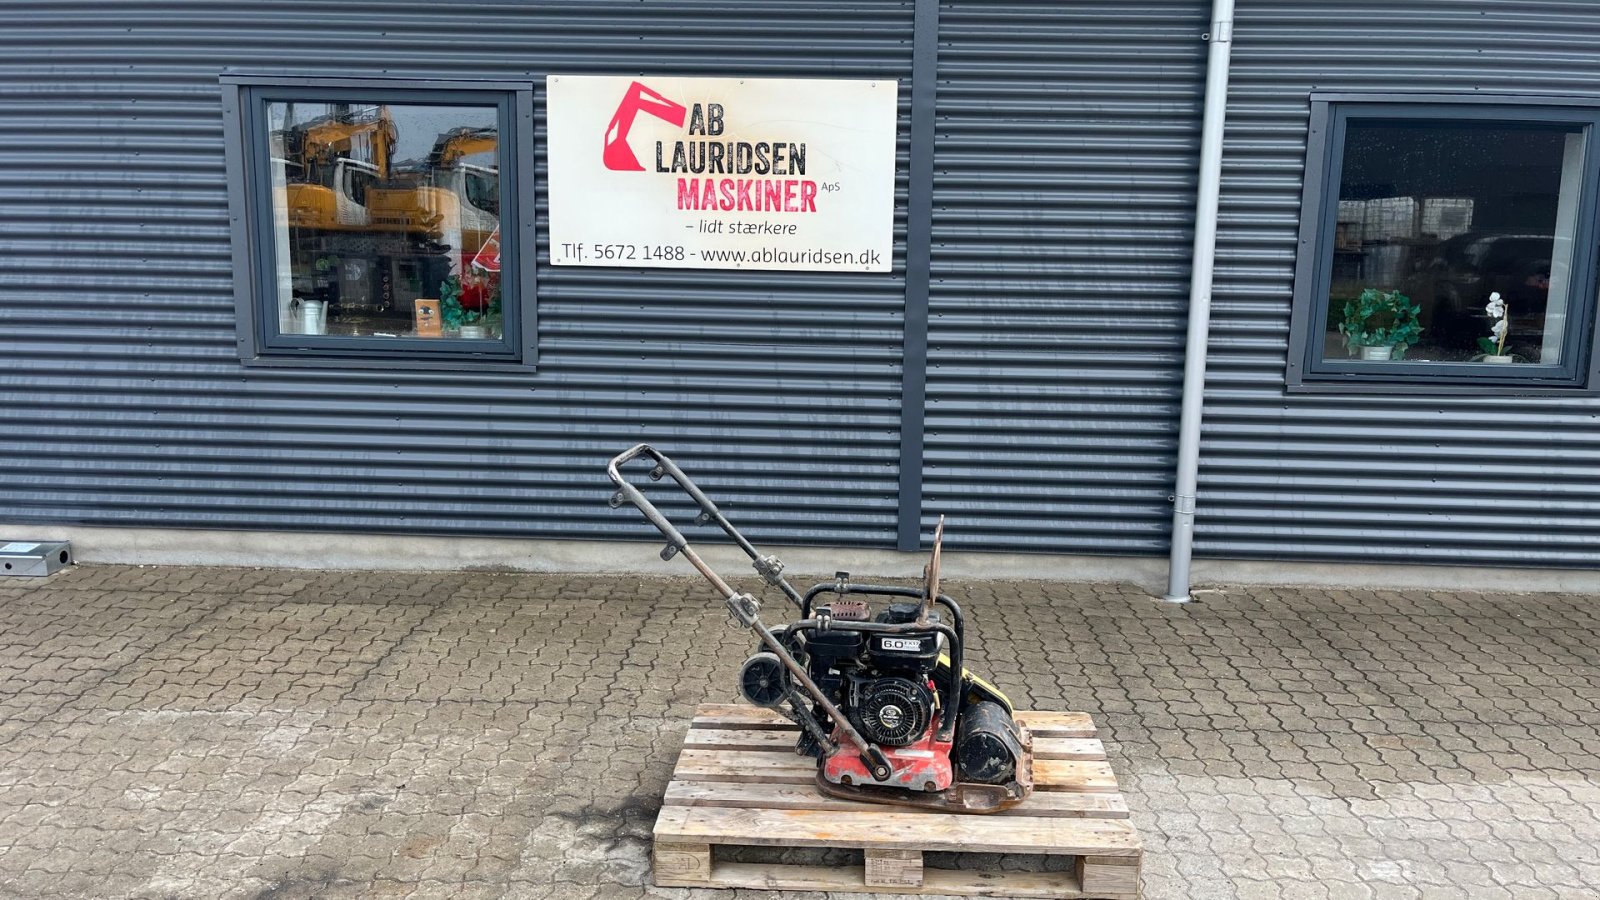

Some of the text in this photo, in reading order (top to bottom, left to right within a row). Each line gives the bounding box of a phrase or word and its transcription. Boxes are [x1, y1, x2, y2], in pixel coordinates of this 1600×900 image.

[688, 103, 725, 136] AB
[656, 141, 806, 176] LAURIDSEN
[677, 178, 841, 213] MASKINER ApS
[699, 219, 724, 234] lidt
[728, 220, 798, 235] stærkere
[561, 243, 588, 262] Tlf.
[594, 244, 636, 260] 5672
[642, 245, 685, 261] 1488
[701, 247, 881, 265] www.ablauridsen.dk
[884, 640, 903, 649] 6.0
